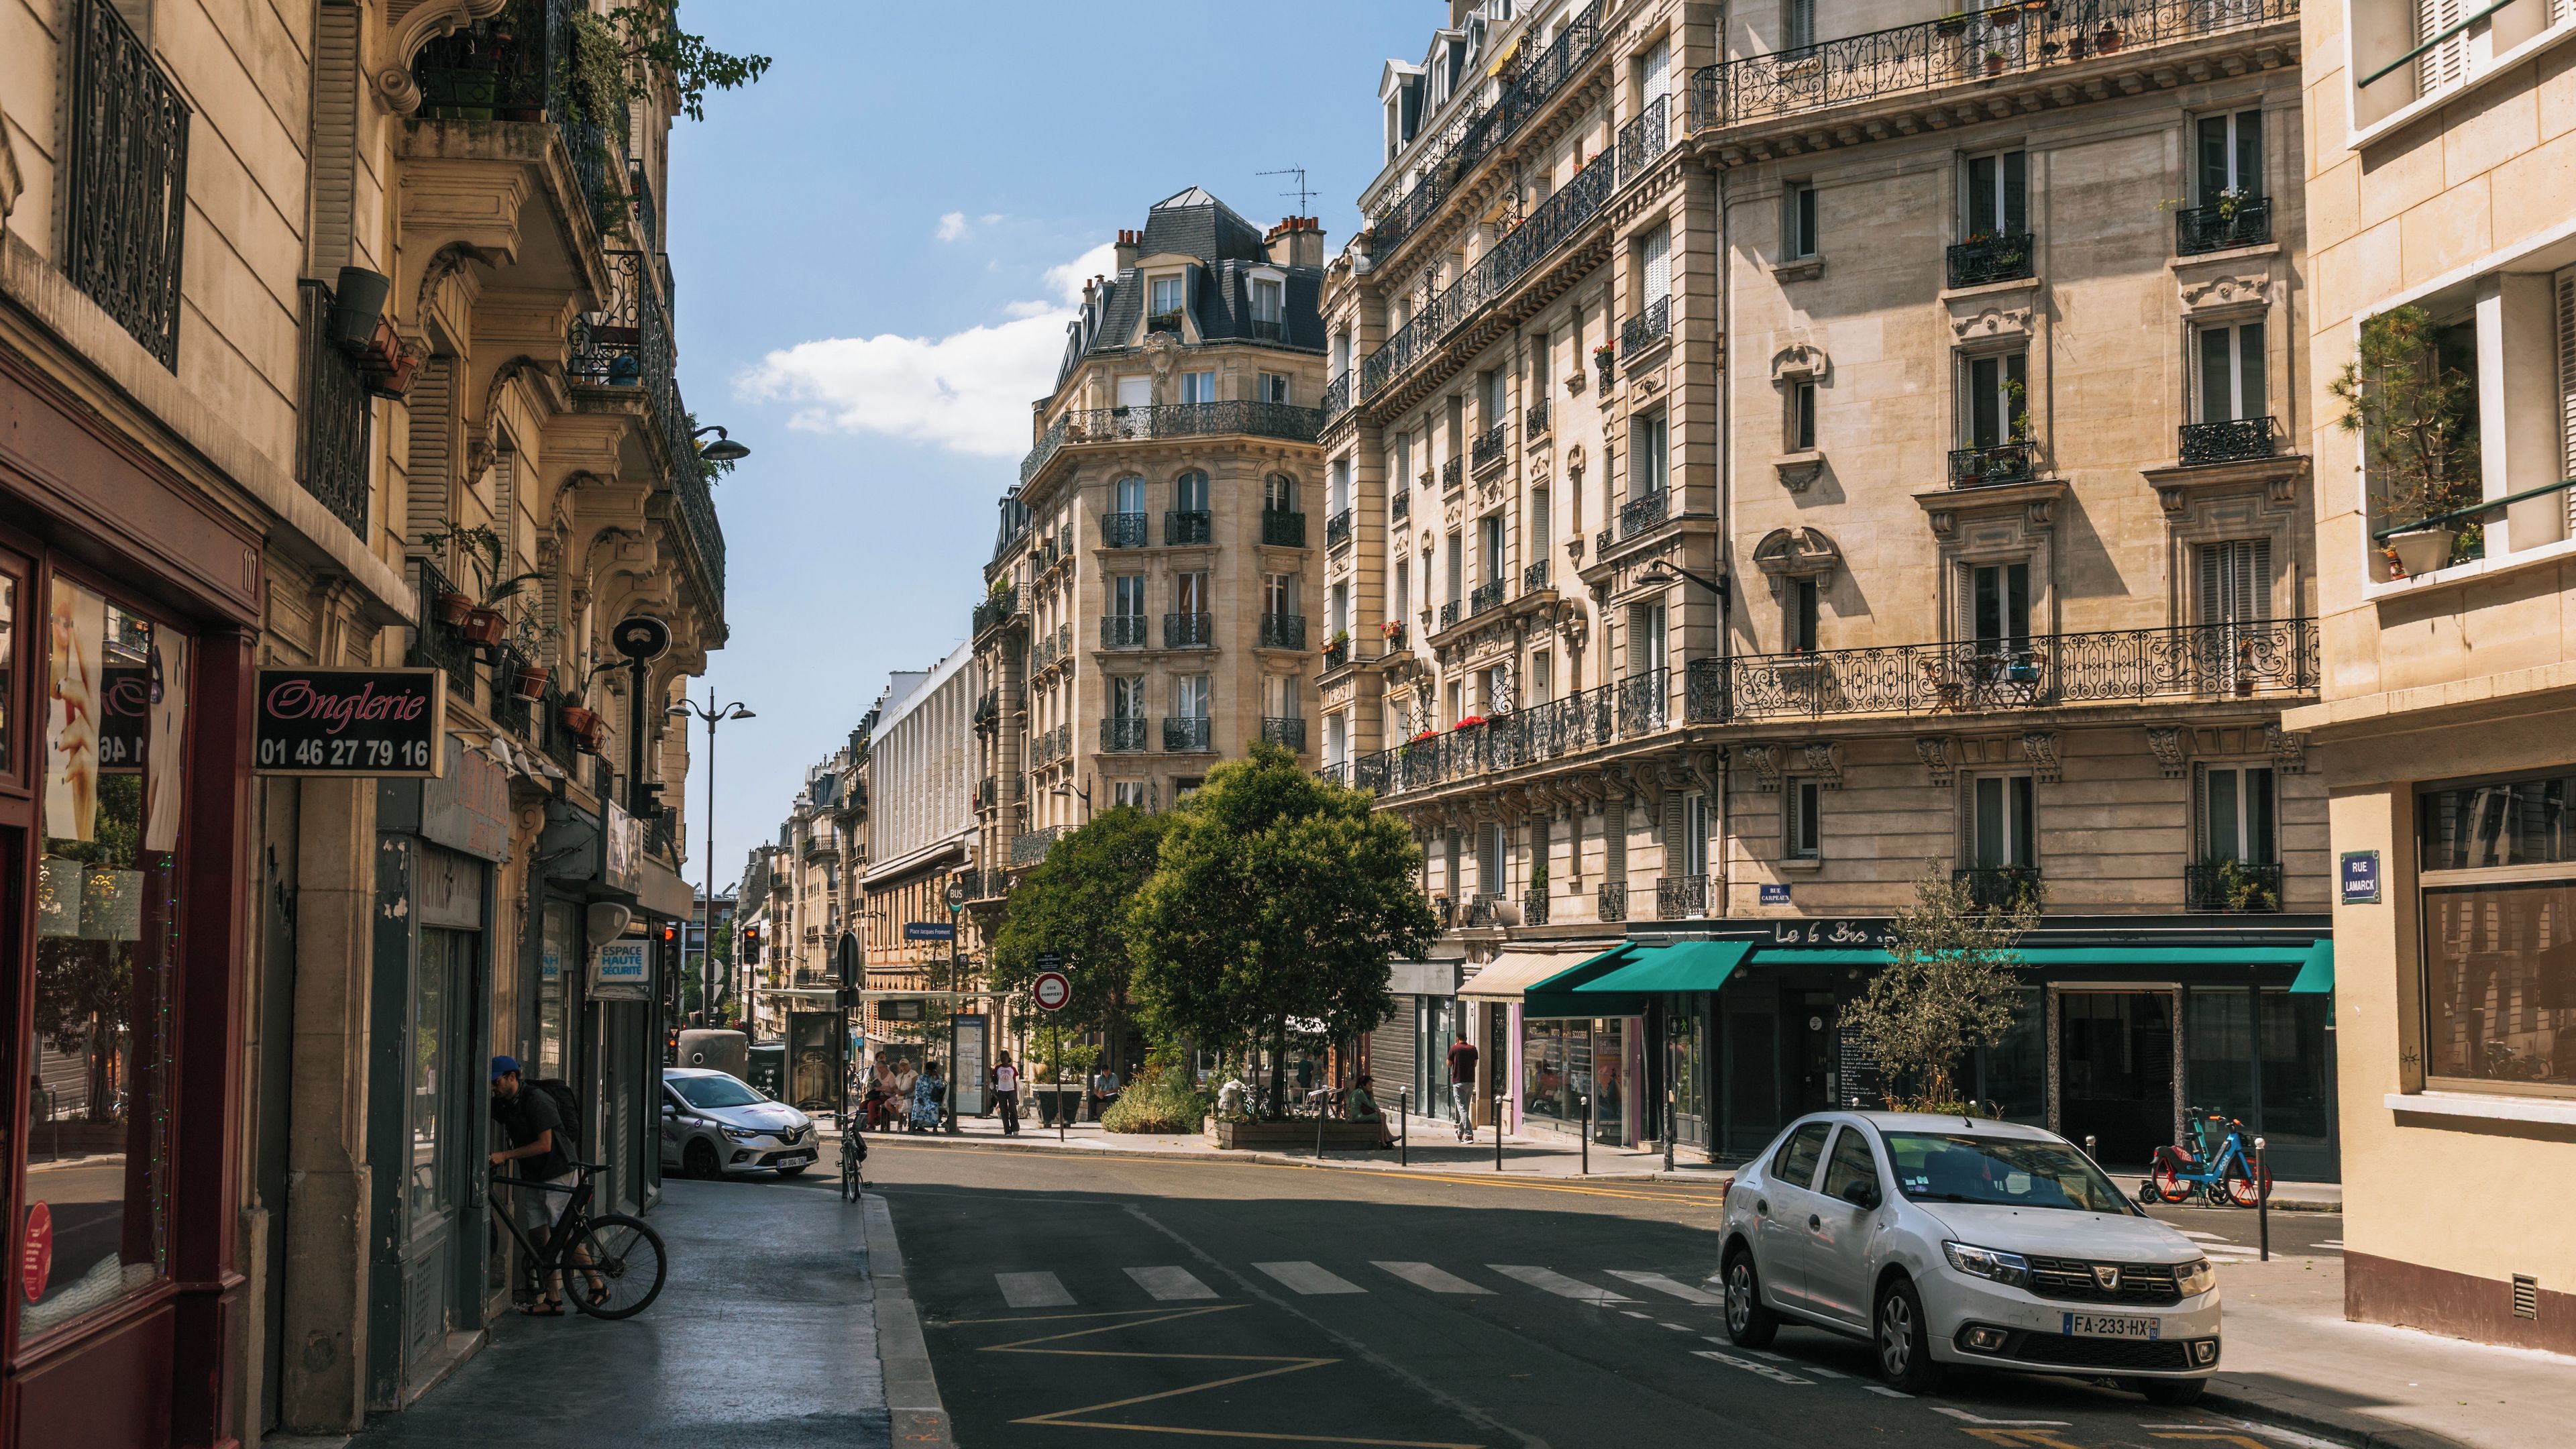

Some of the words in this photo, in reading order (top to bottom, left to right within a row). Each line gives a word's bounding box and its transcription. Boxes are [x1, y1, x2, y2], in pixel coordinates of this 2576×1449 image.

[244, 549, 256, 592] 117
[267, 680, 425, 734] Onglerie
[260, 739, 286, 765] 01
[295, 739, 323, 765] 46
[330, 739, 359, 765] 27
[366, 740, 394, 765] 79
[401, 741, 428, 766] 16
[2353, 861, 2367, 872] RUE
[2345, 879, 2374, 891] LAMARCK
[950, 889, 963, 898] BUS
[1776, 921, 1800, 943] Le
[1808, 921, 1820, 943] 6
[1828, 921, 1868, 943] Bis
[602, 947, 642, 956] ESPACE
[602, 956, 642, 965] HAUTE
[602, 964, 642, 975] SÉCURITÉ
[2182, 1150, 2192, 1161] FREE
[2219, 1155, 2231, 1171] dott
[2075, 1316, 2147, 1336] FA-233-HX
